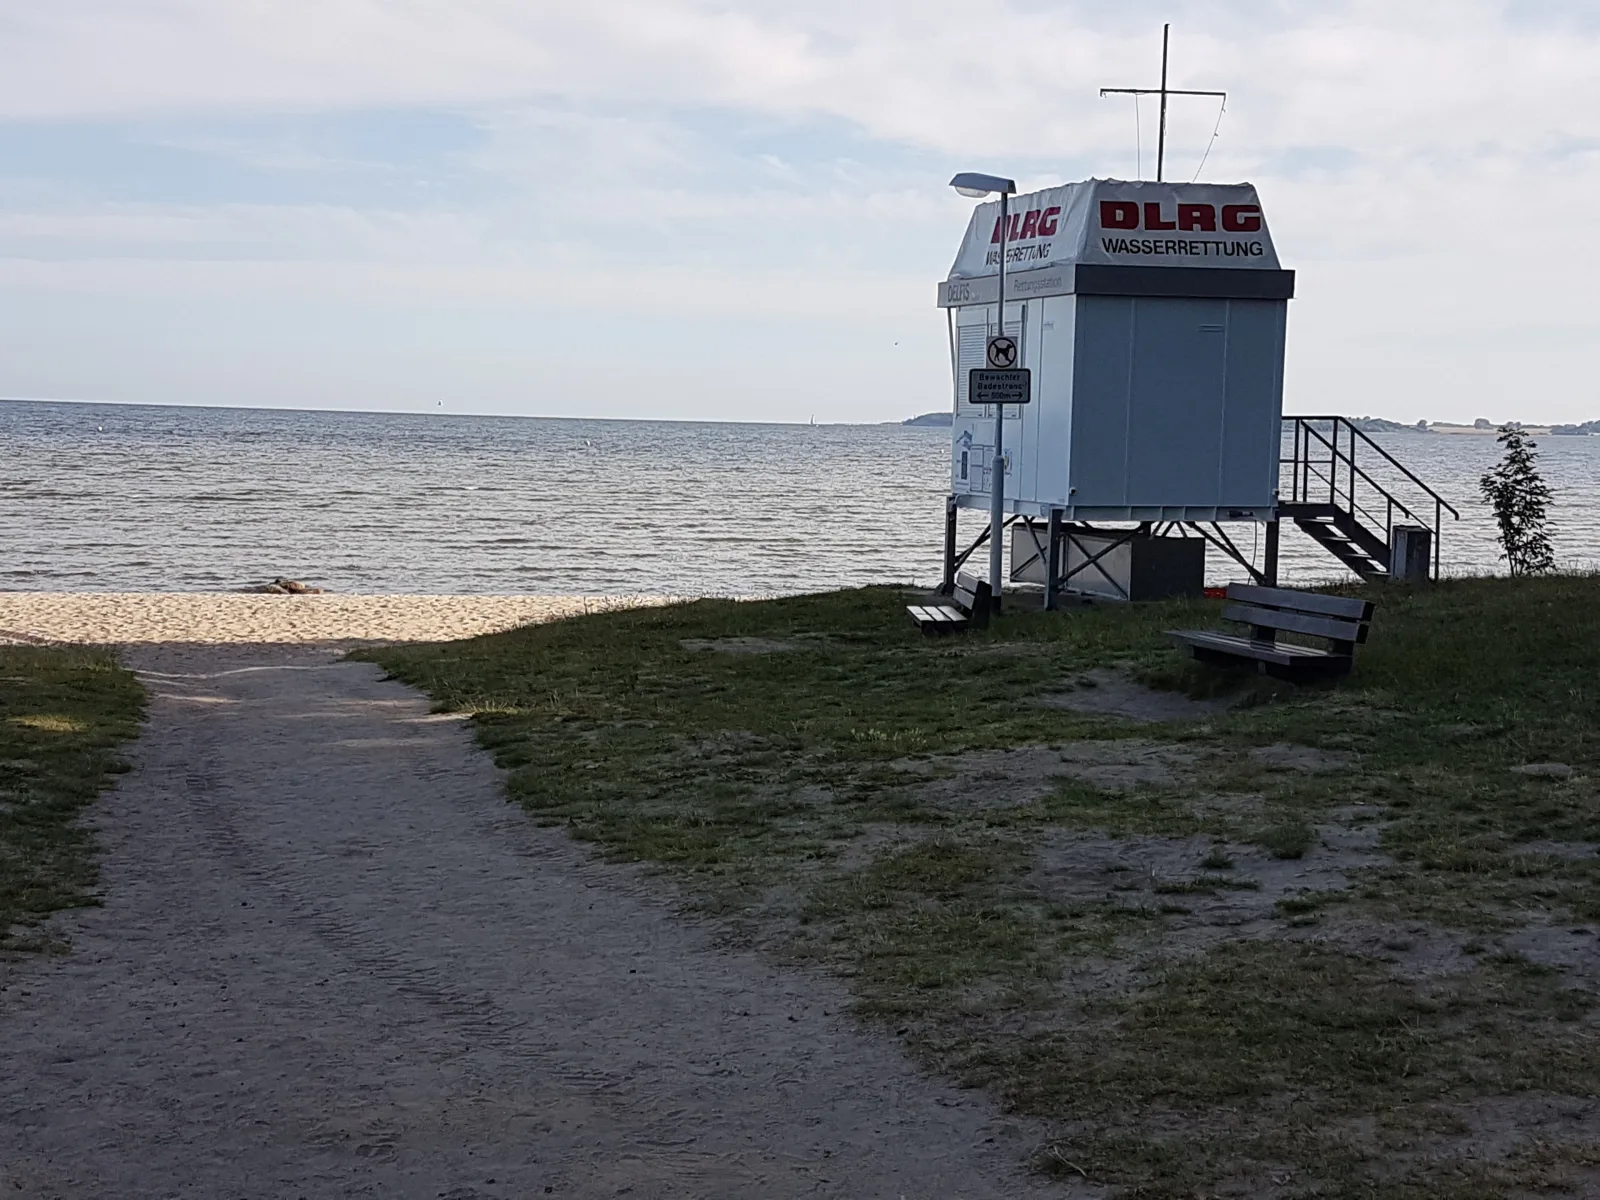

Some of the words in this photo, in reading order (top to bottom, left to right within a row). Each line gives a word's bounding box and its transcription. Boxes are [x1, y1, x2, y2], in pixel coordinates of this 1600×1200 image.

[990, 206, 1061, 244] DLRG
[1099, 200, 1261, 233] DLRG
[985, 243, 1052, 266] WASERRETTUNG
[1101, 237, 1264, 257] WASSERRETTUNG
